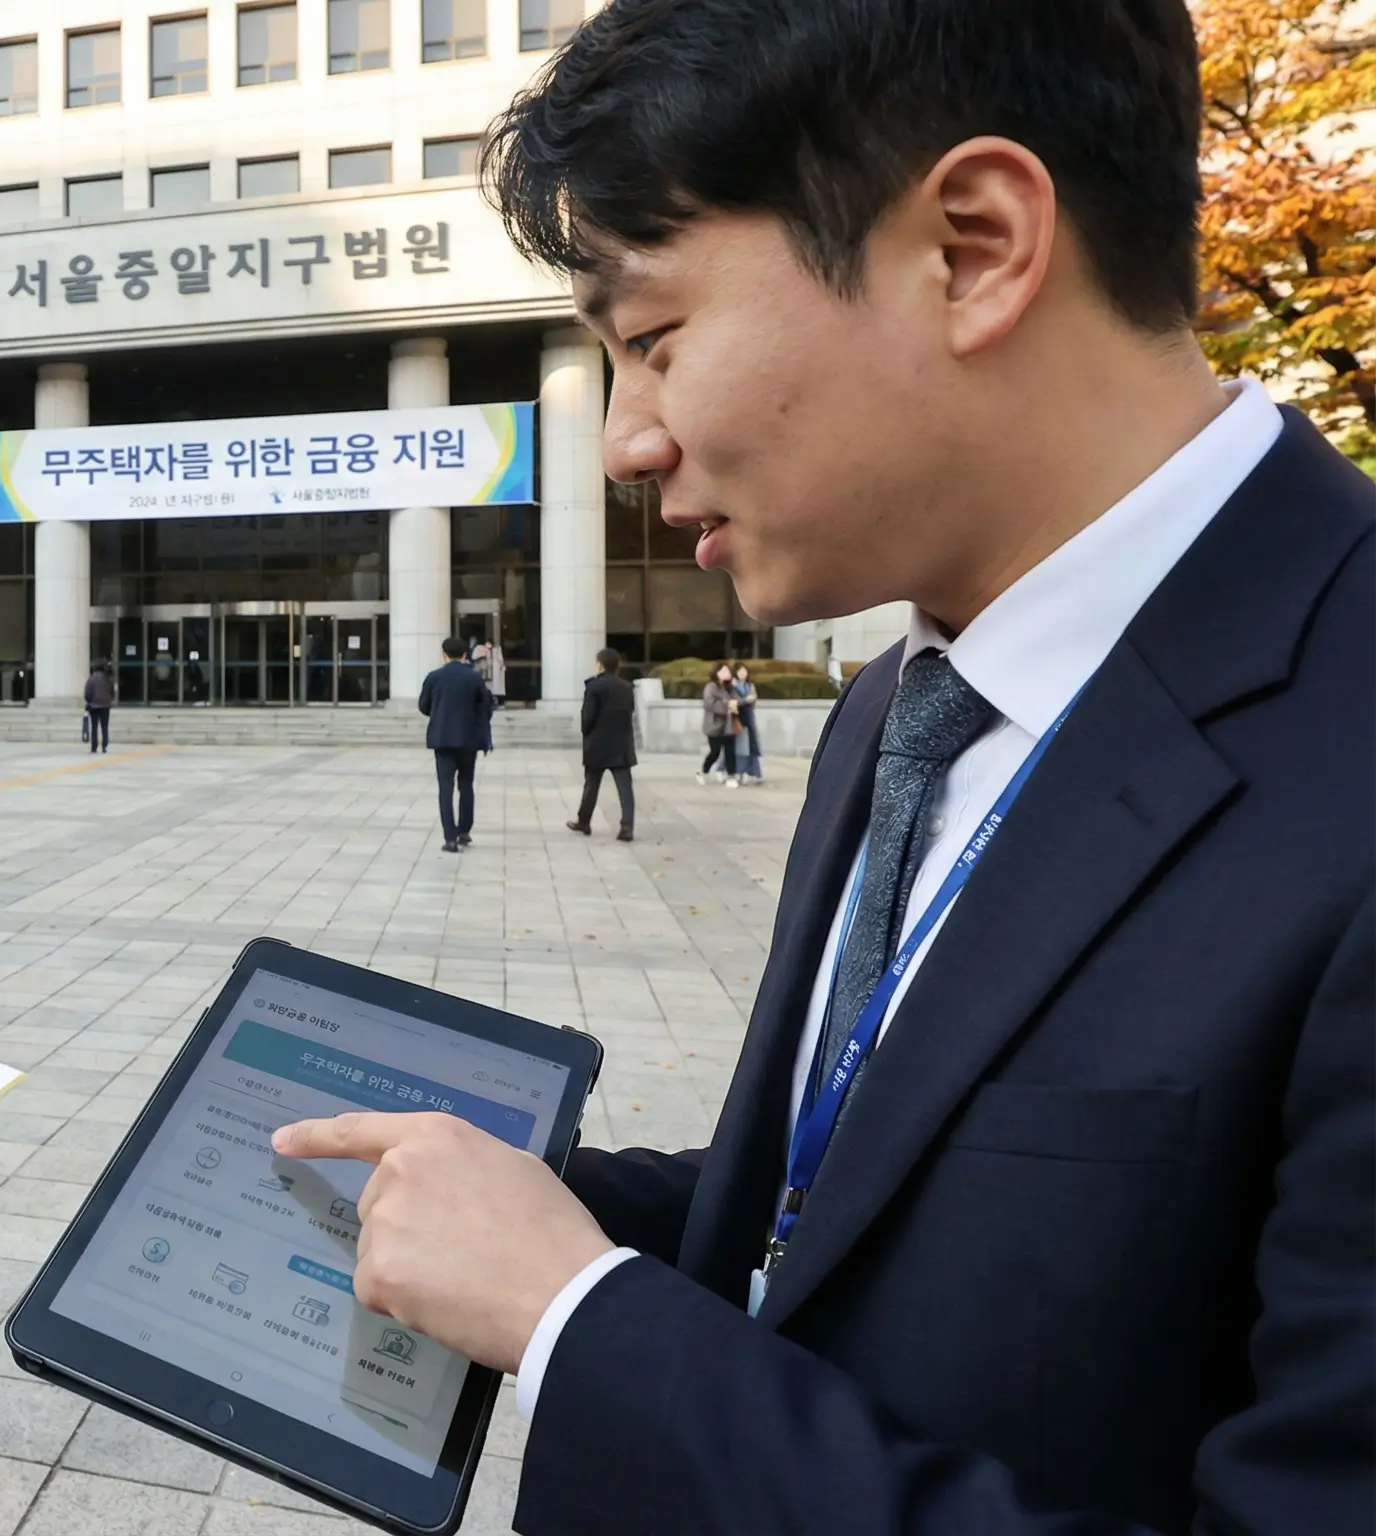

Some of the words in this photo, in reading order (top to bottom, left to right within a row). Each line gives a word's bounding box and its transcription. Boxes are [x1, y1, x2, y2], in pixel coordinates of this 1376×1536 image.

[8, 222, 450, 307] 서울중알지구법원
[41, 442, 213, 486] 무주택자를
[224, 436, 294, 479] 위한
[306, 433, 379, 475] 금융
[392, 428, 465, 471] 지원
[129, 495, 157, 508] 2024
